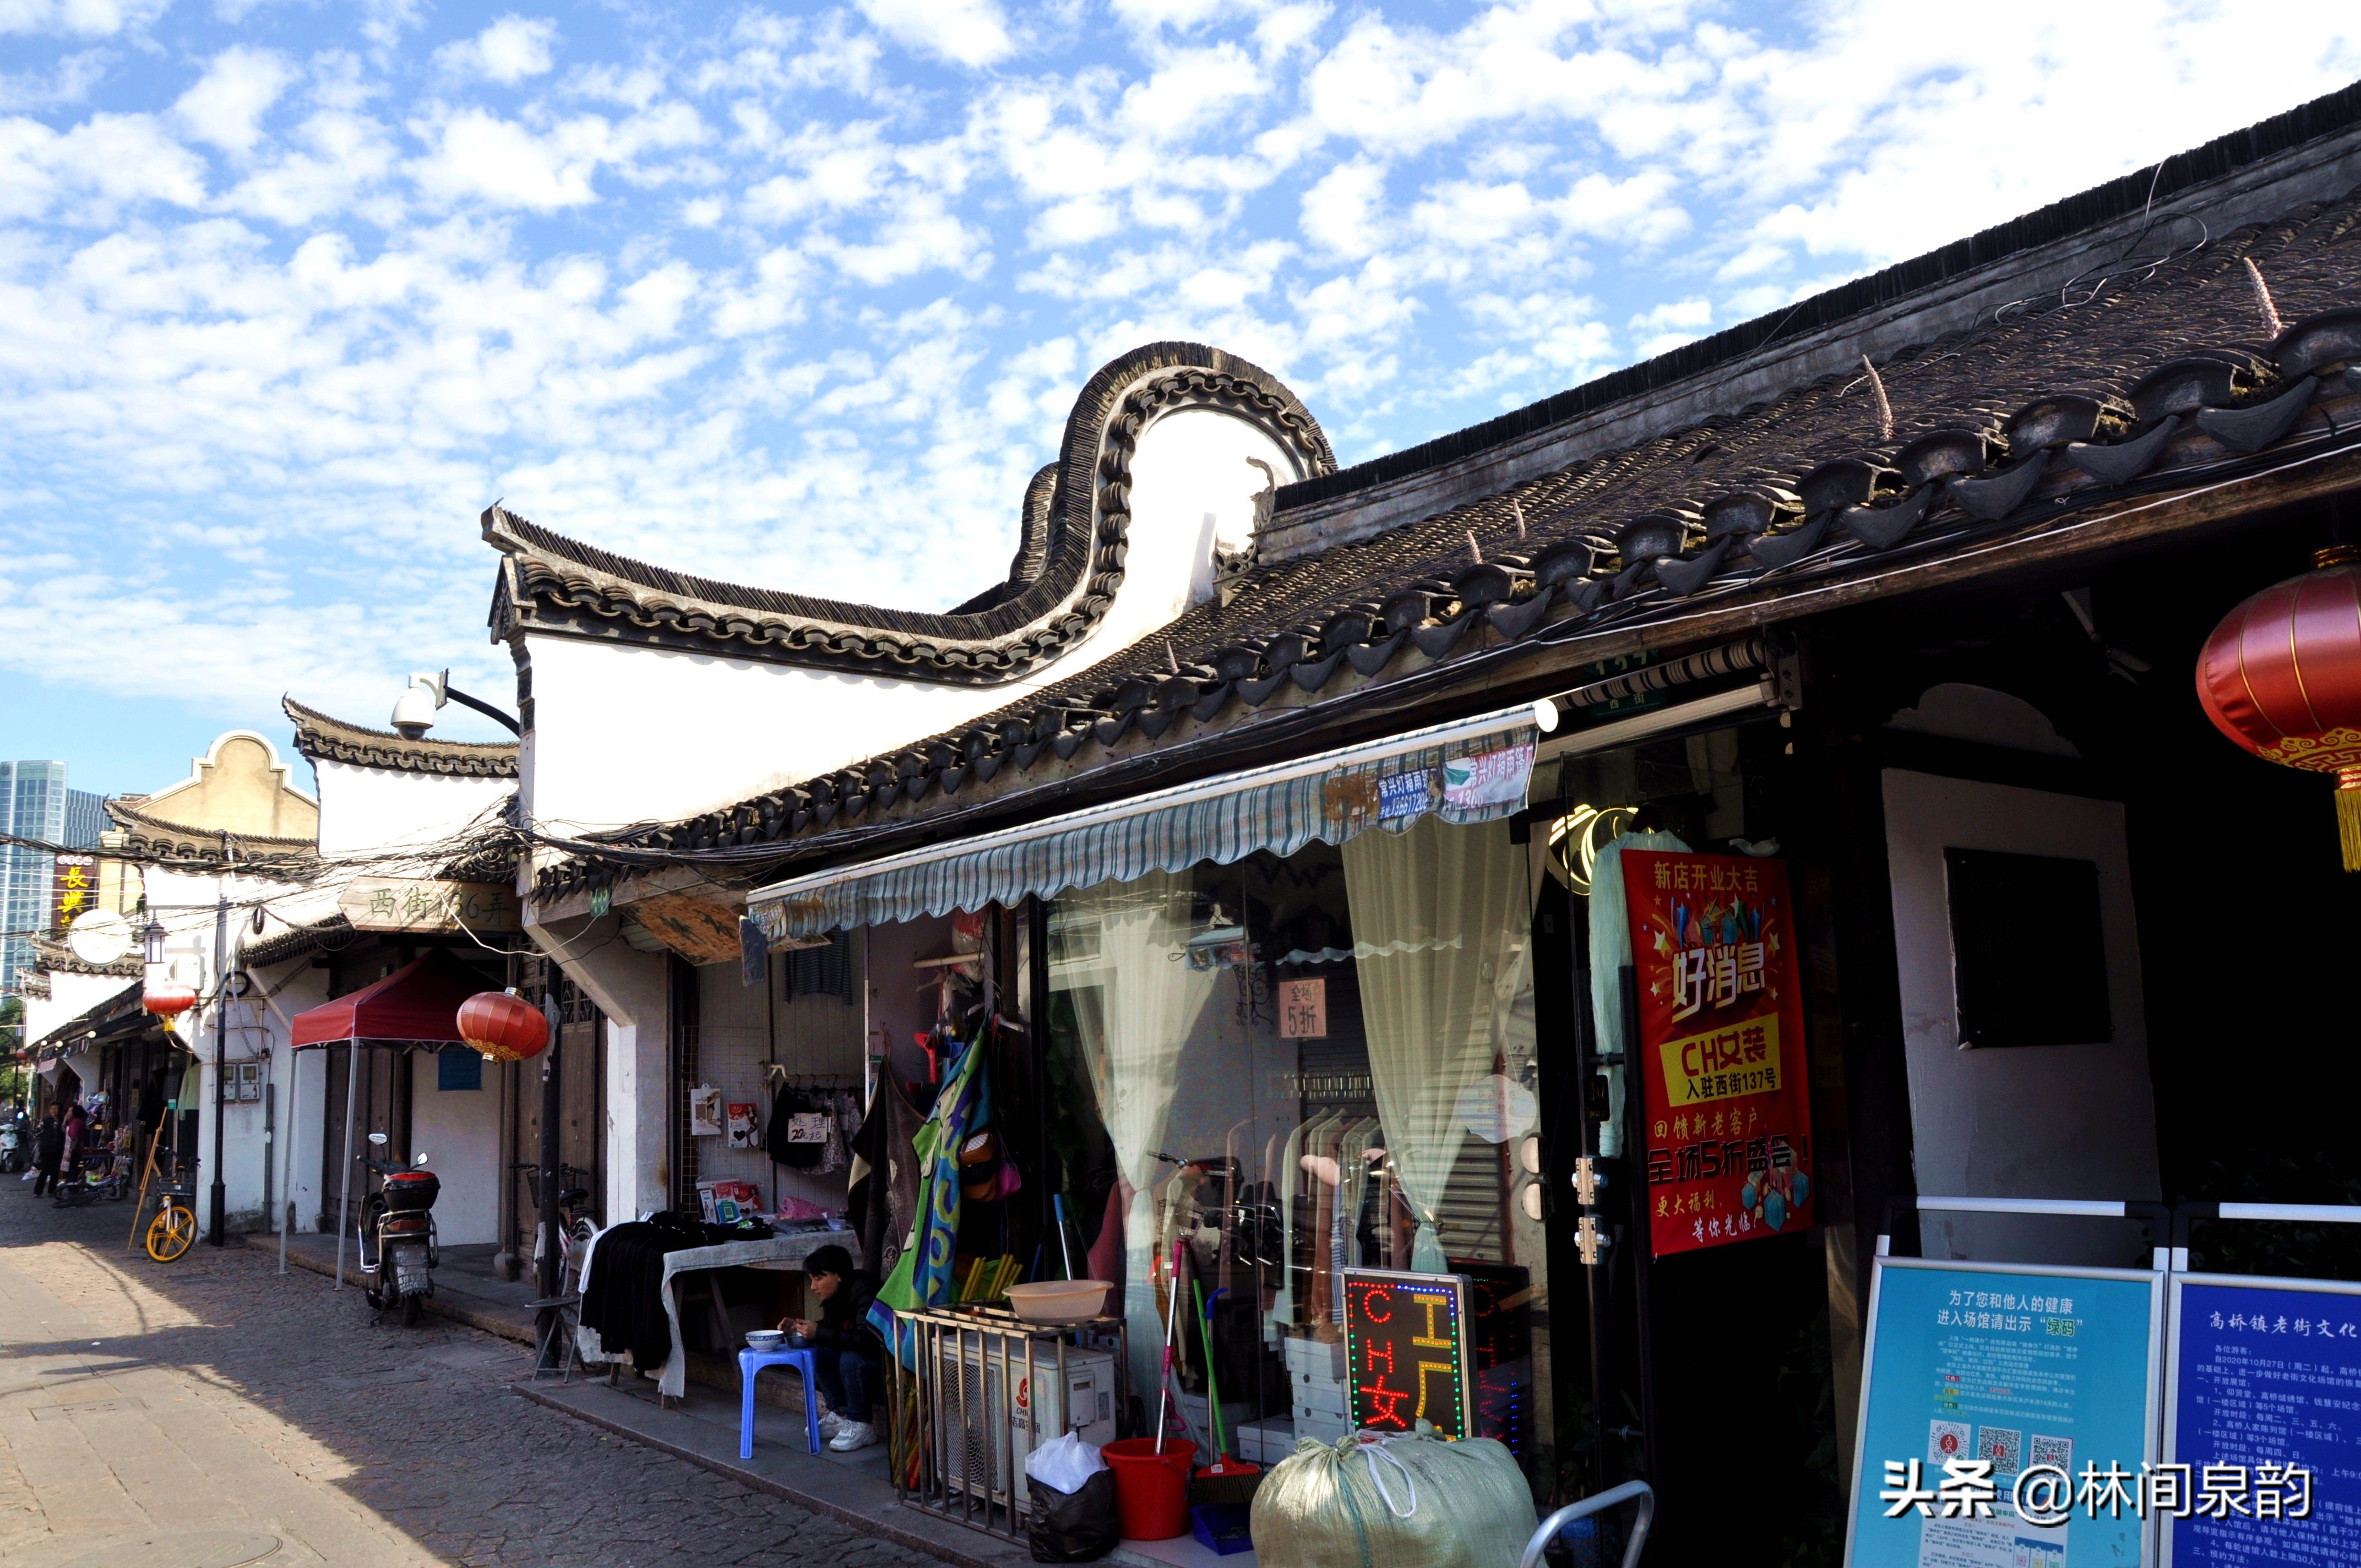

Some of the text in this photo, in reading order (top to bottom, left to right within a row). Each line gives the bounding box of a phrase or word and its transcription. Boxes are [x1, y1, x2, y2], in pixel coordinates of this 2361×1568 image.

[1654, 861, 1758, 892] 新店开业大吉
[369, 887, 510, 924] 西街136弄
[1291, 984, 1312, 1001] 全场
[1672, 942, 1765, 1024] 好消息
[1288, 1005, 1316, 1036] 5折
[1681, 1026, 1766, 1077] CH女装
[1687, 1067, 1776, 1100] 入驻西街137号
[791, 1117, 826, 1129] 处理
[1950, 1289, 2073, 1315] 为了您和他人的健康
[2210, 1311, 2357, 1338] 高桥镇老街文化
[1412, 1294, 1457, 1441] 工厂
